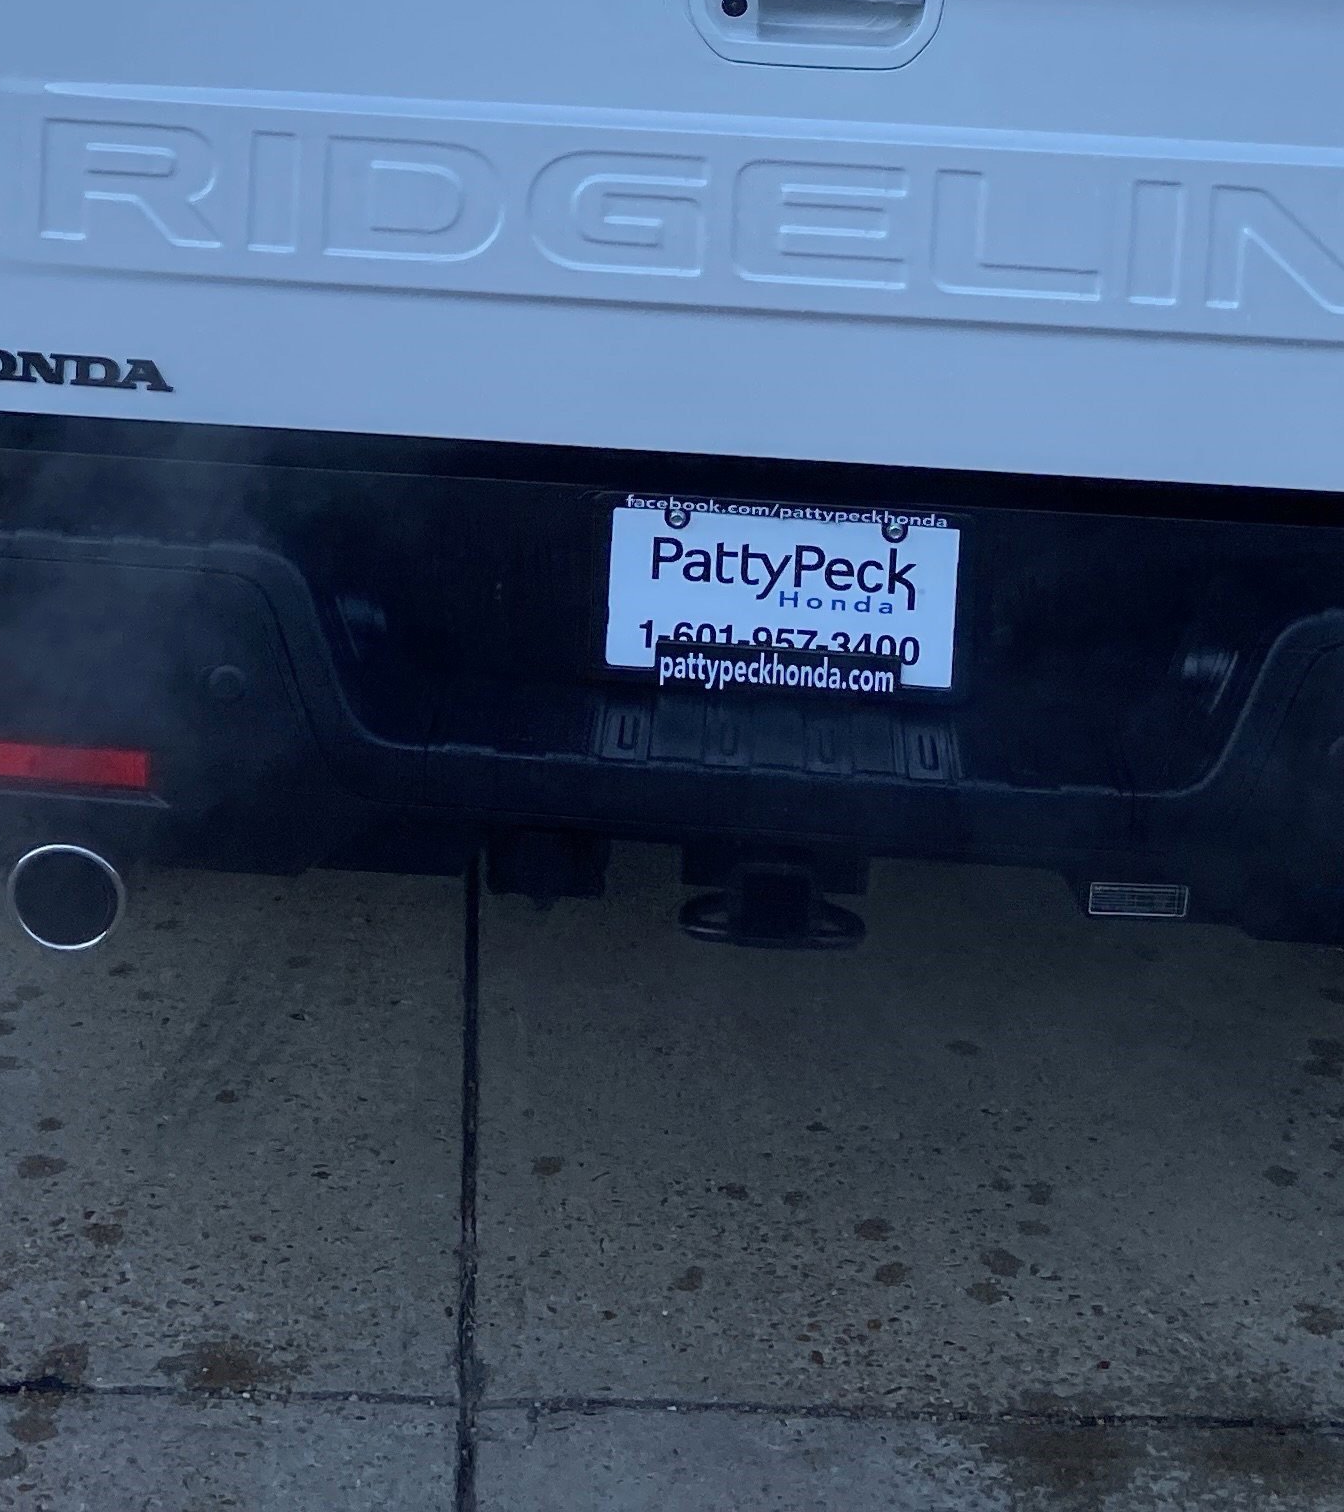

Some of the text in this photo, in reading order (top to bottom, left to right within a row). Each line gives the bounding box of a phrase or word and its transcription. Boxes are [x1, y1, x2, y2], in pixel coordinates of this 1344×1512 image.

[626, 494, 949, 529] facebook.com/pattypeckhonda
[651, 535, 917, 612] PattyPeck
[778, 590, 894, 615] Honda
[639, 619, 920, 667] 1-601-957-3400
[659, 652, 895, 693] pattypeckhonda.com
